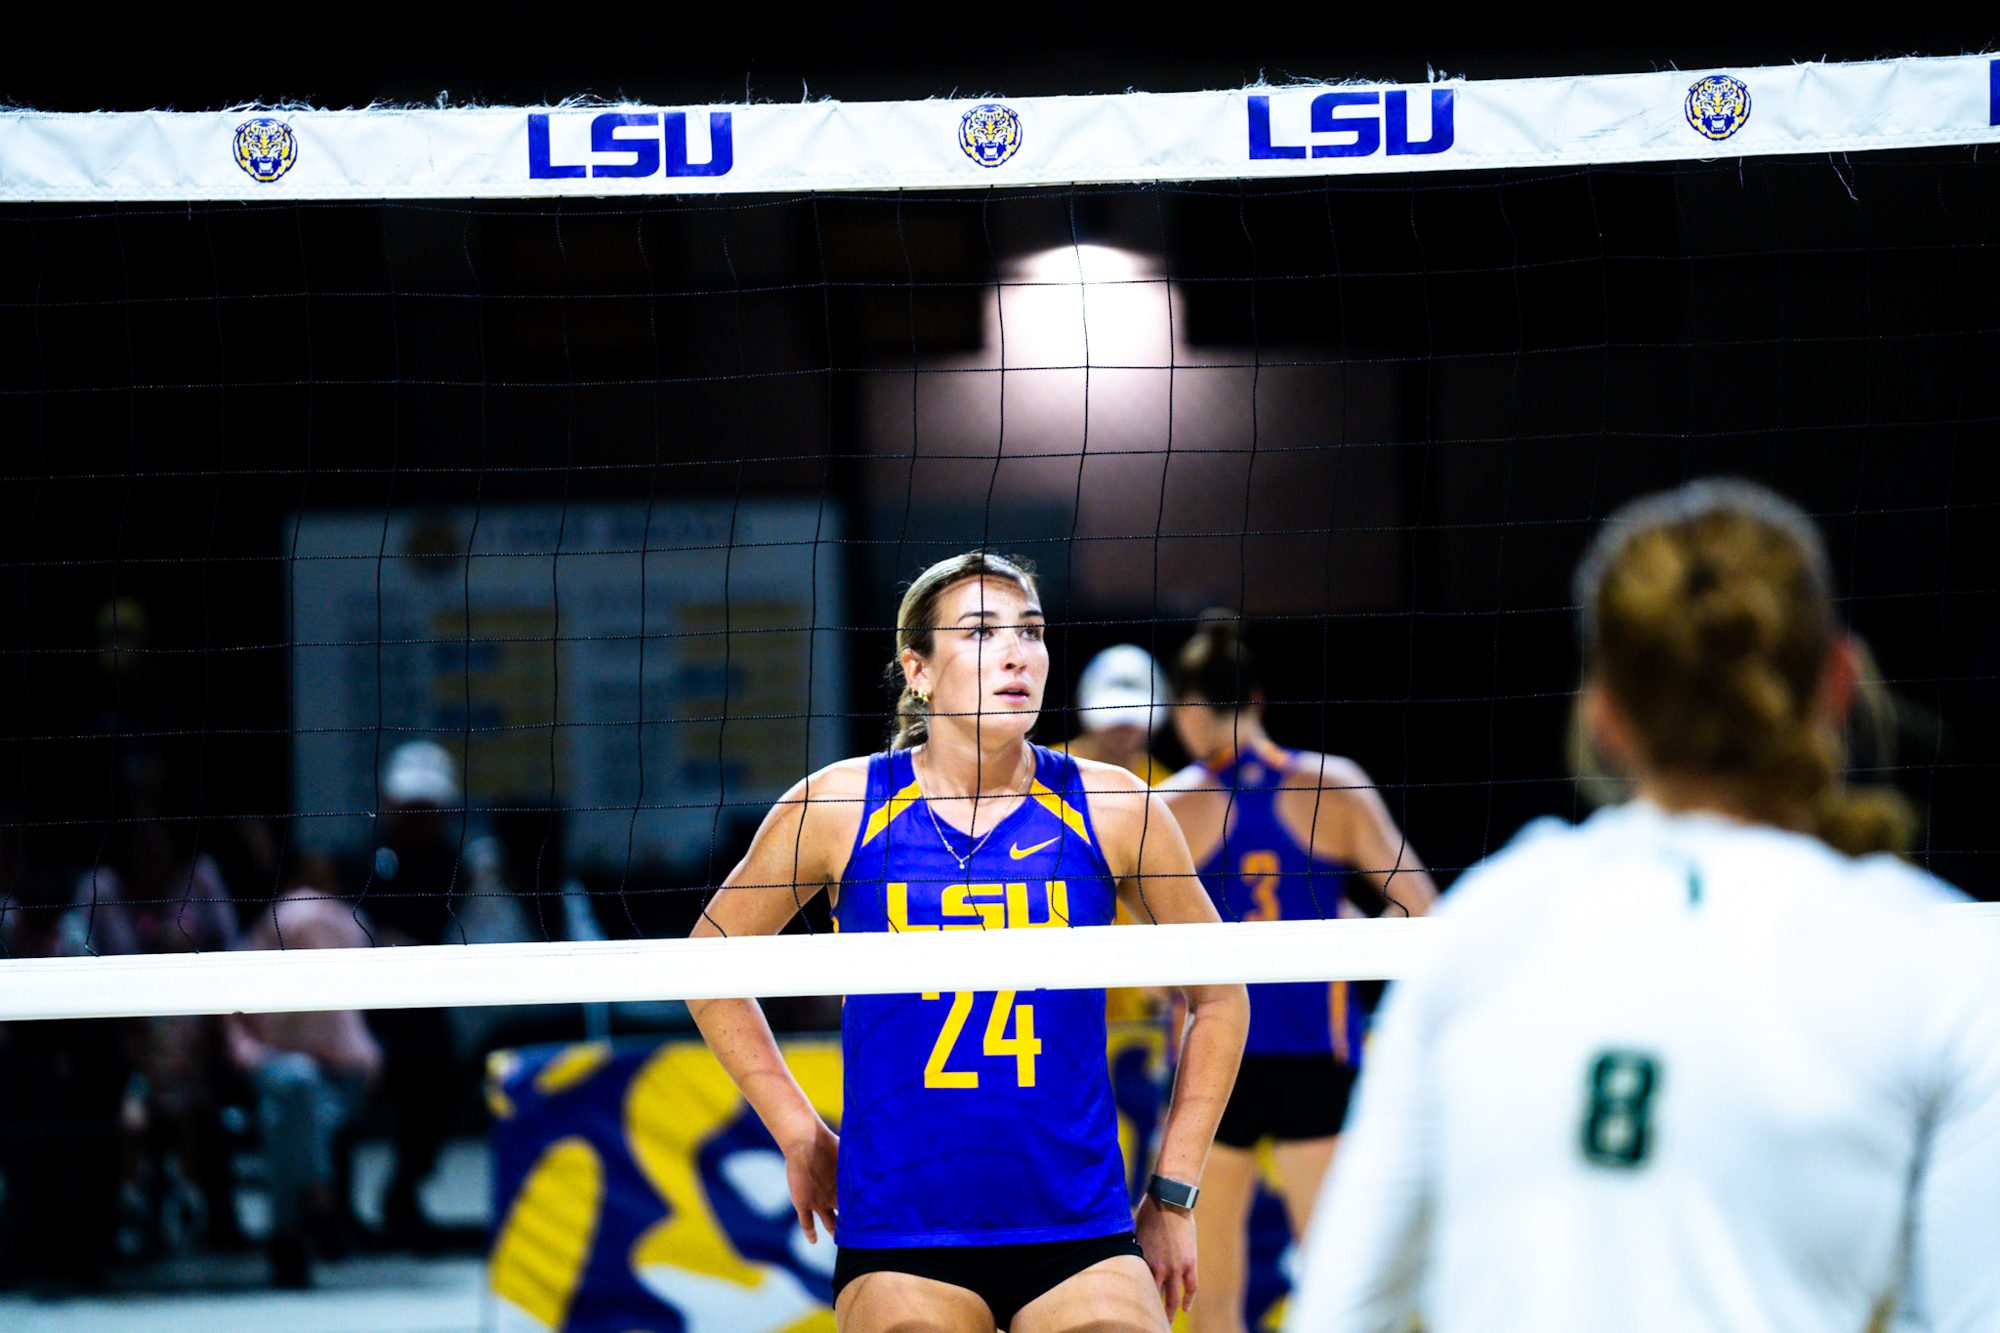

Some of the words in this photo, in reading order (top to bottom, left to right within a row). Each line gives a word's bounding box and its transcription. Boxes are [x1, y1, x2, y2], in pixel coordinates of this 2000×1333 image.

[528, 112, 734, 180] LSU
[1248, 89, 1455, 160] LSU
[887, 881, 1069, 932] LSU
[1240, 850, 1282, 921] 3
[922, 990, 1042, 1088] 24
[1582, 1048, 1662, 1170] 8
